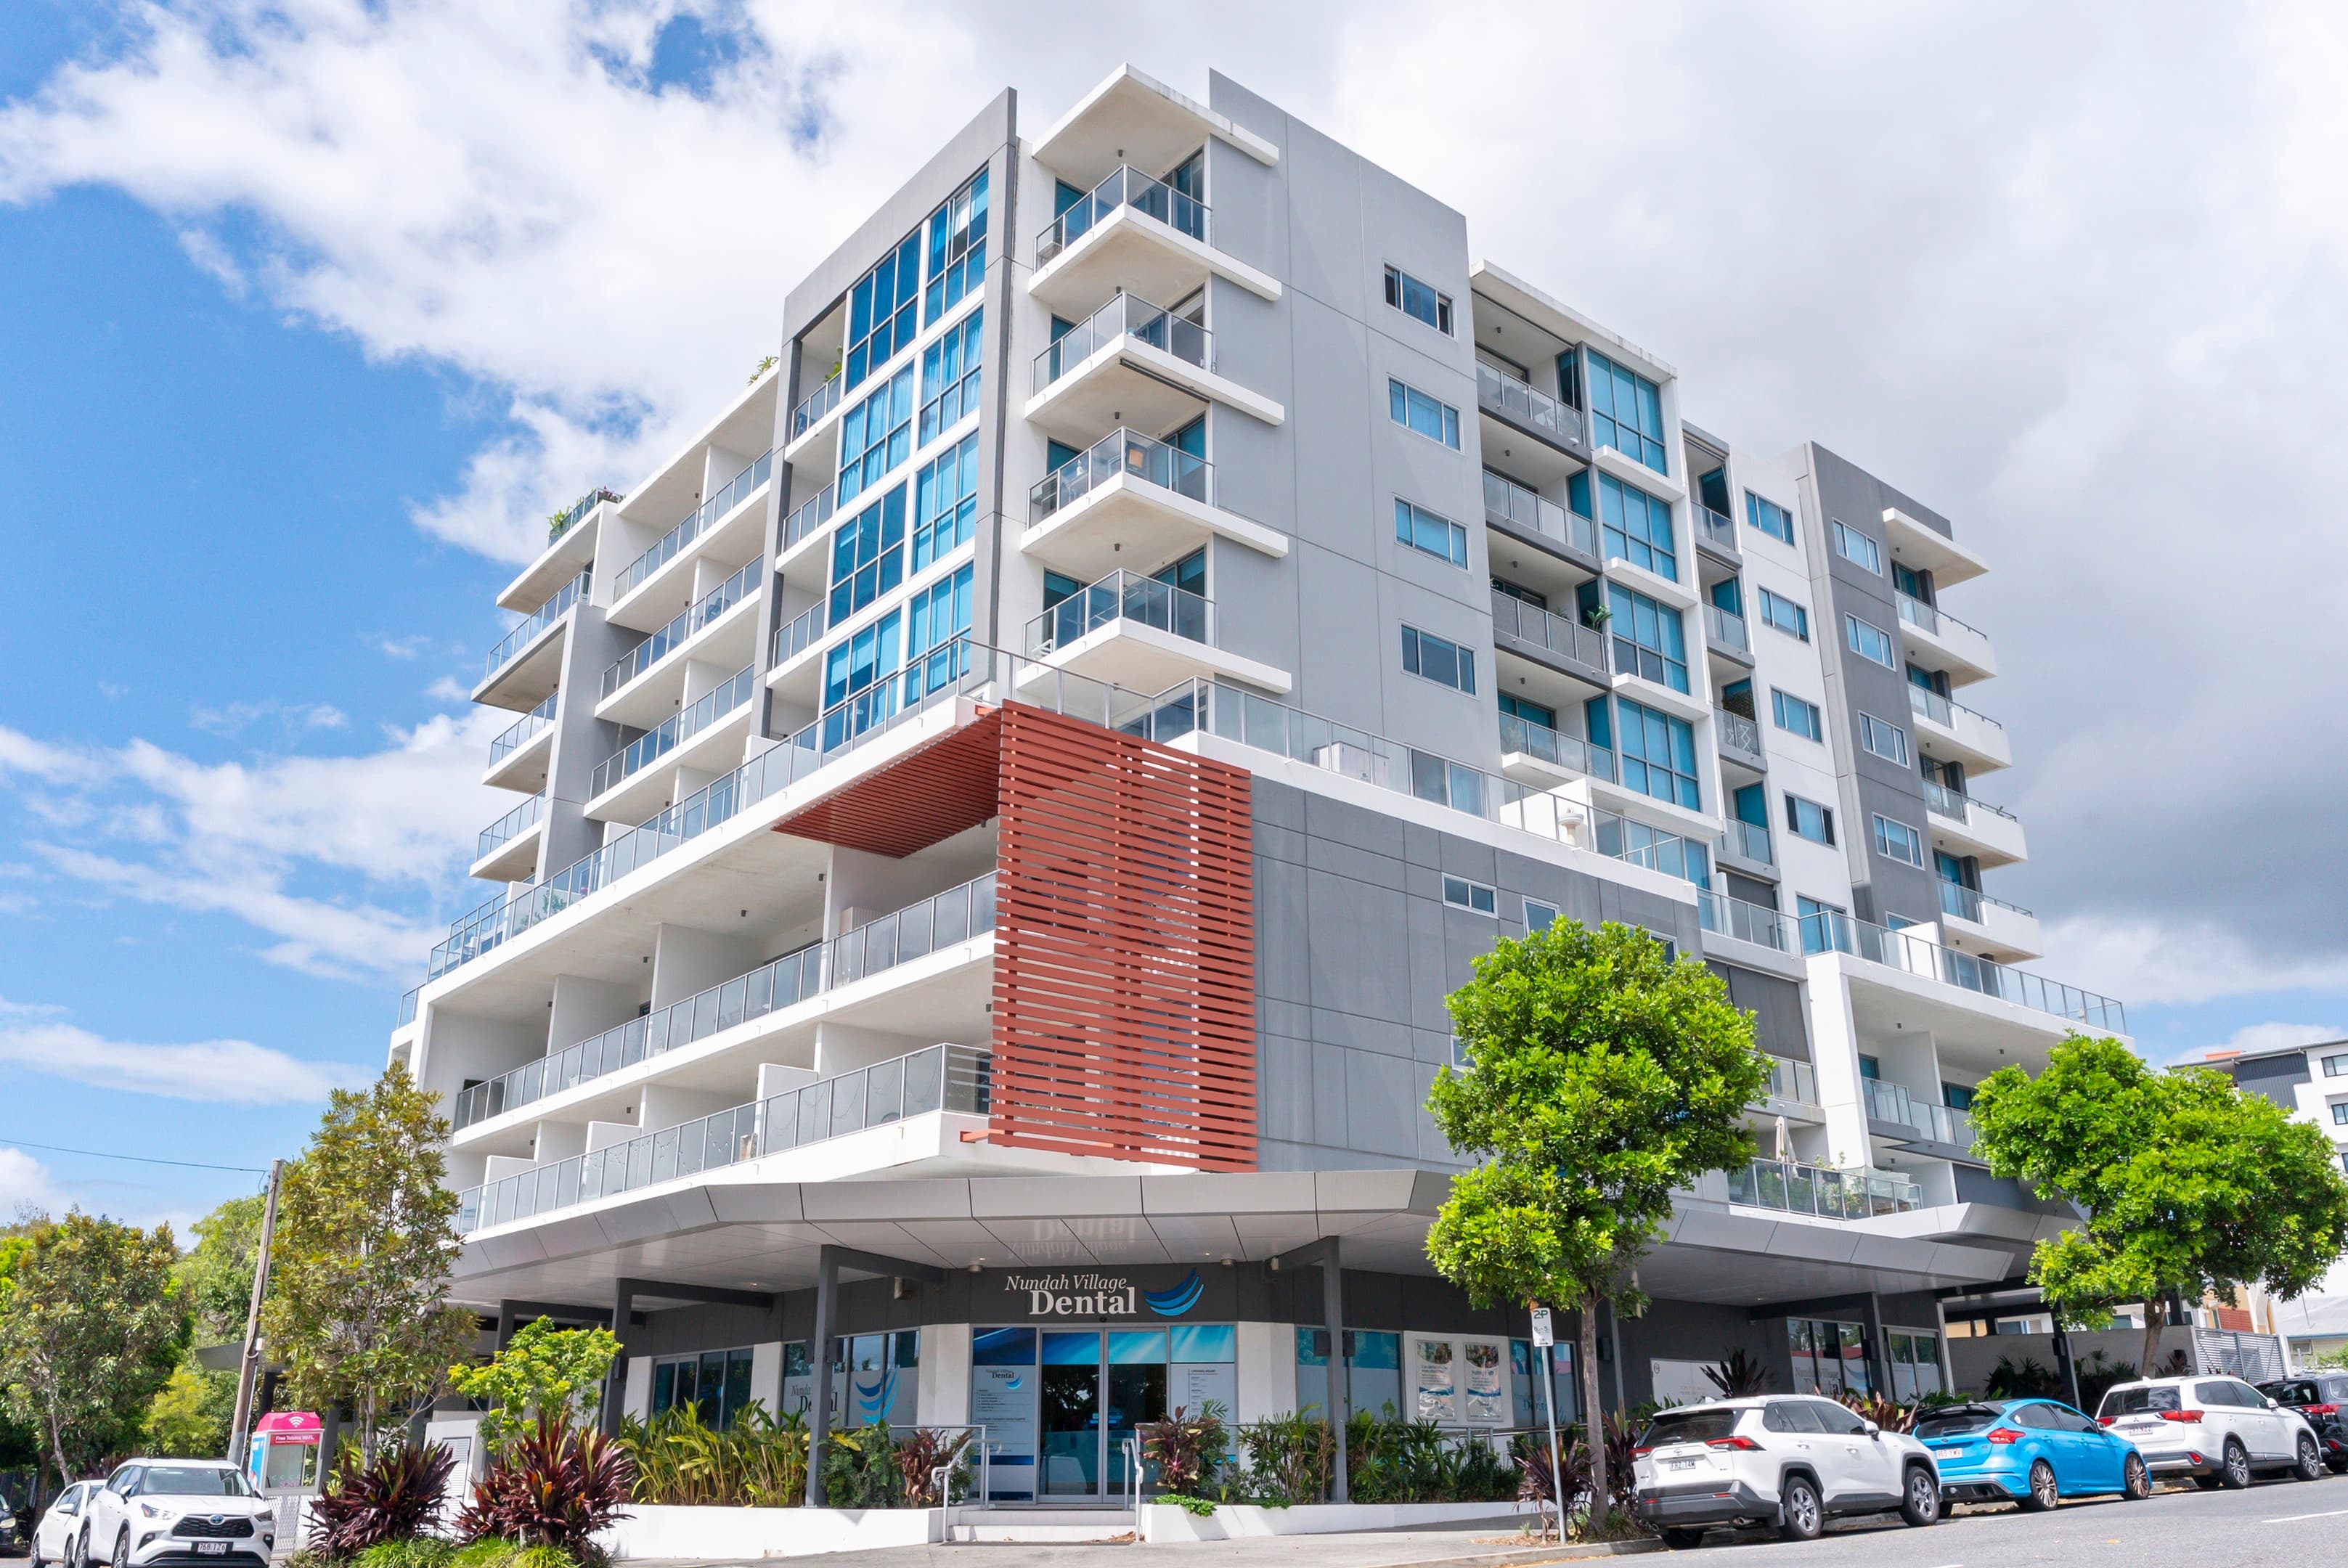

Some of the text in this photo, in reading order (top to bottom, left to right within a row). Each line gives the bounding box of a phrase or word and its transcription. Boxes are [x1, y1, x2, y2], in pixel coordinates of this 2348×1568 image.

[1005, 1274, 1127, 1293] Nundah Village
[1029, 1287, 1137, 1315] Dental
[1533, 1310, 1548, 1318] 2P
[791, 1384, 811, 1396] Nunda
